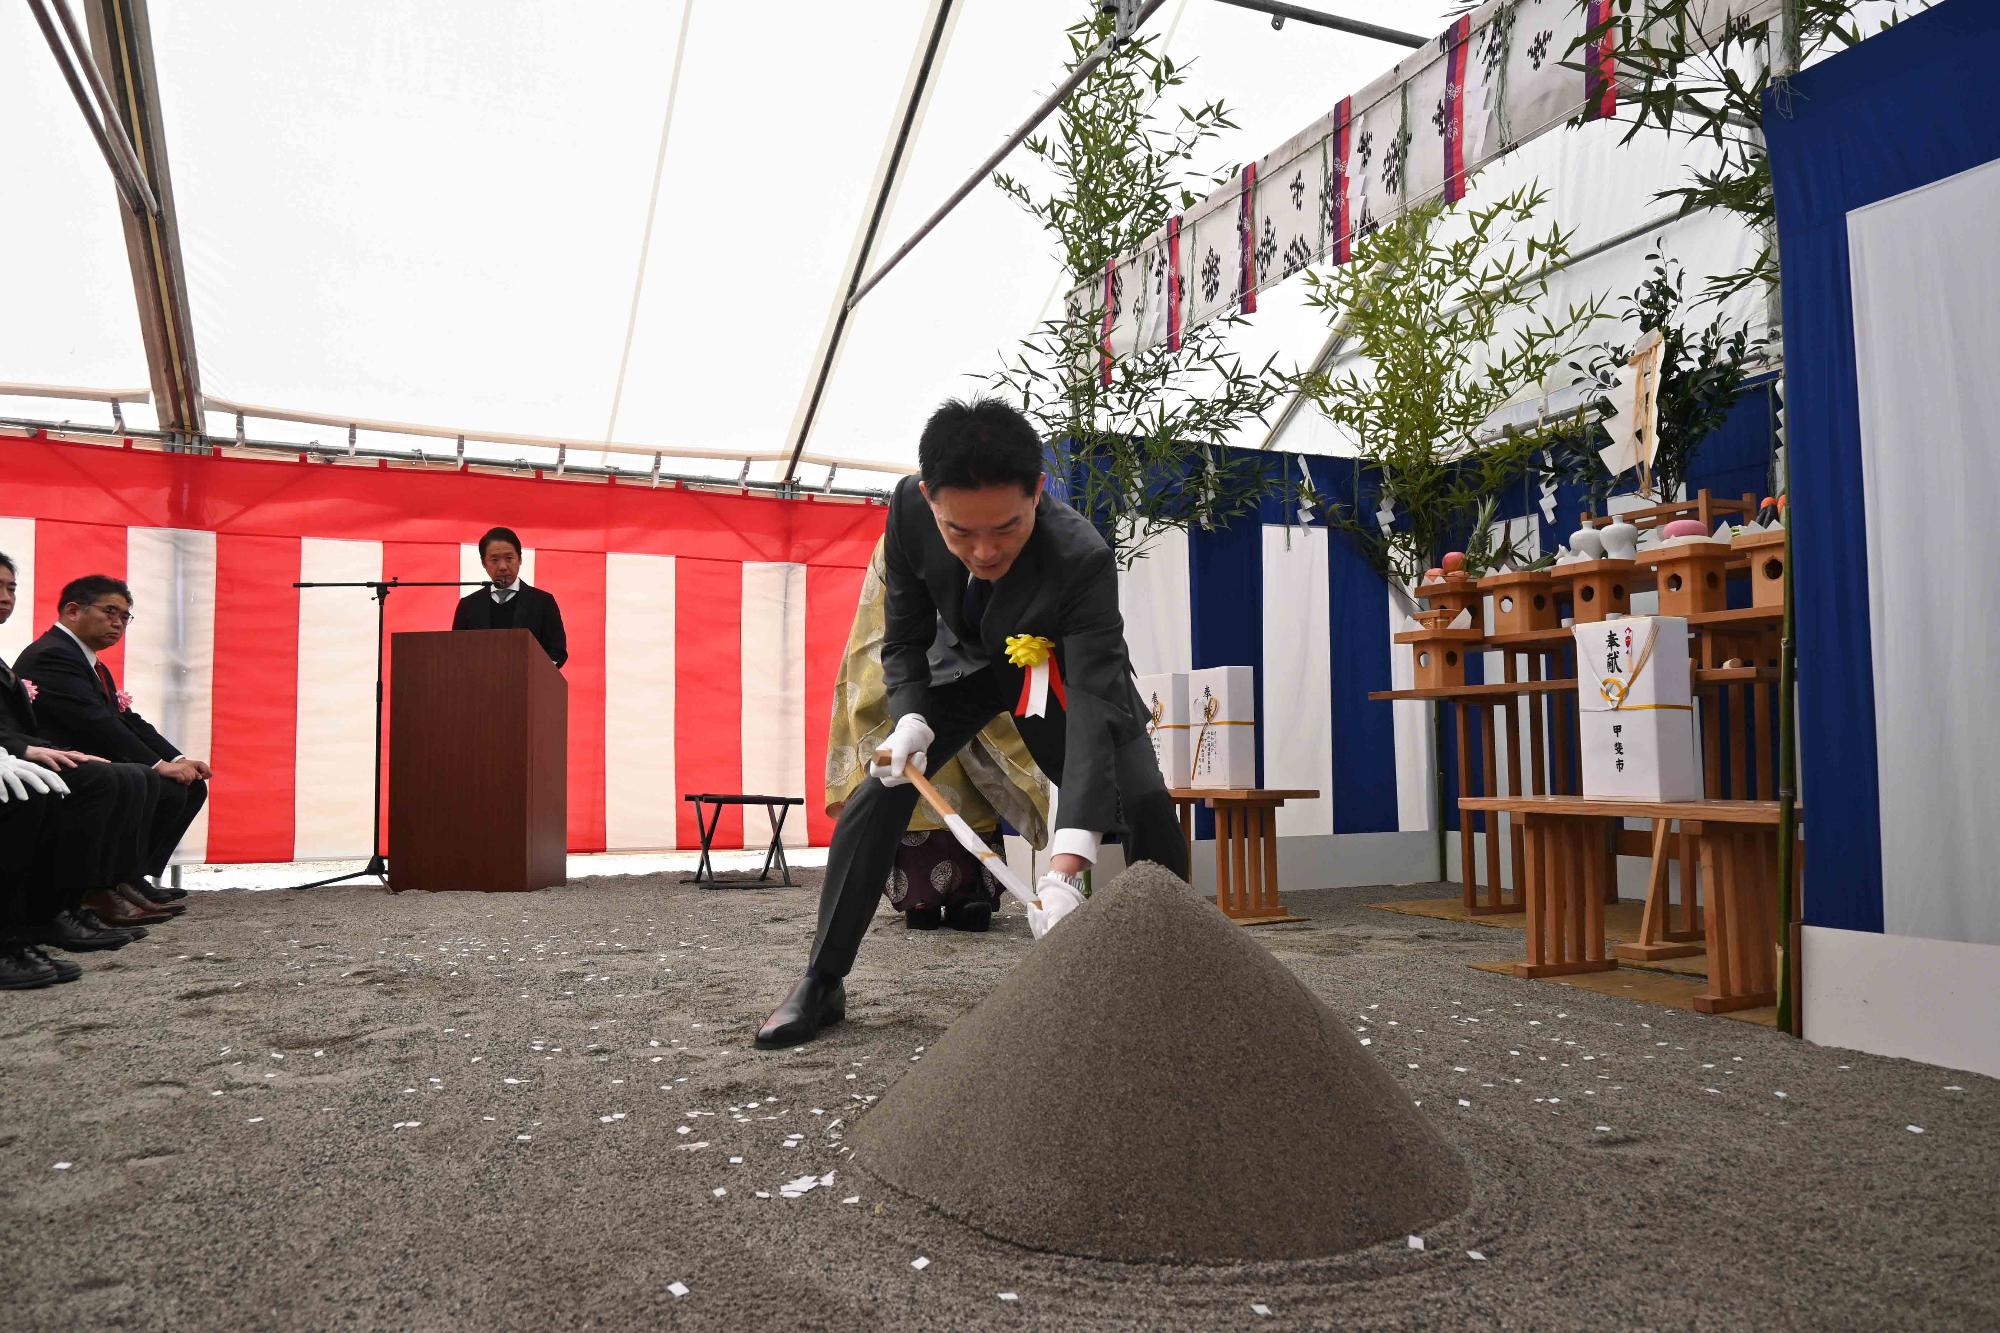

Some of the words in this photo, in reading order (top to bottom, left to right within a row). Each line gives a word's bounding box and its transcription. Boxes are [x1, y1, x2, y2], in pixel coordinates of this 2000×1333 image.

[1605, 630, 1623, 674] 奉献
[1612, 724, 1625, 773] 甲斐市
